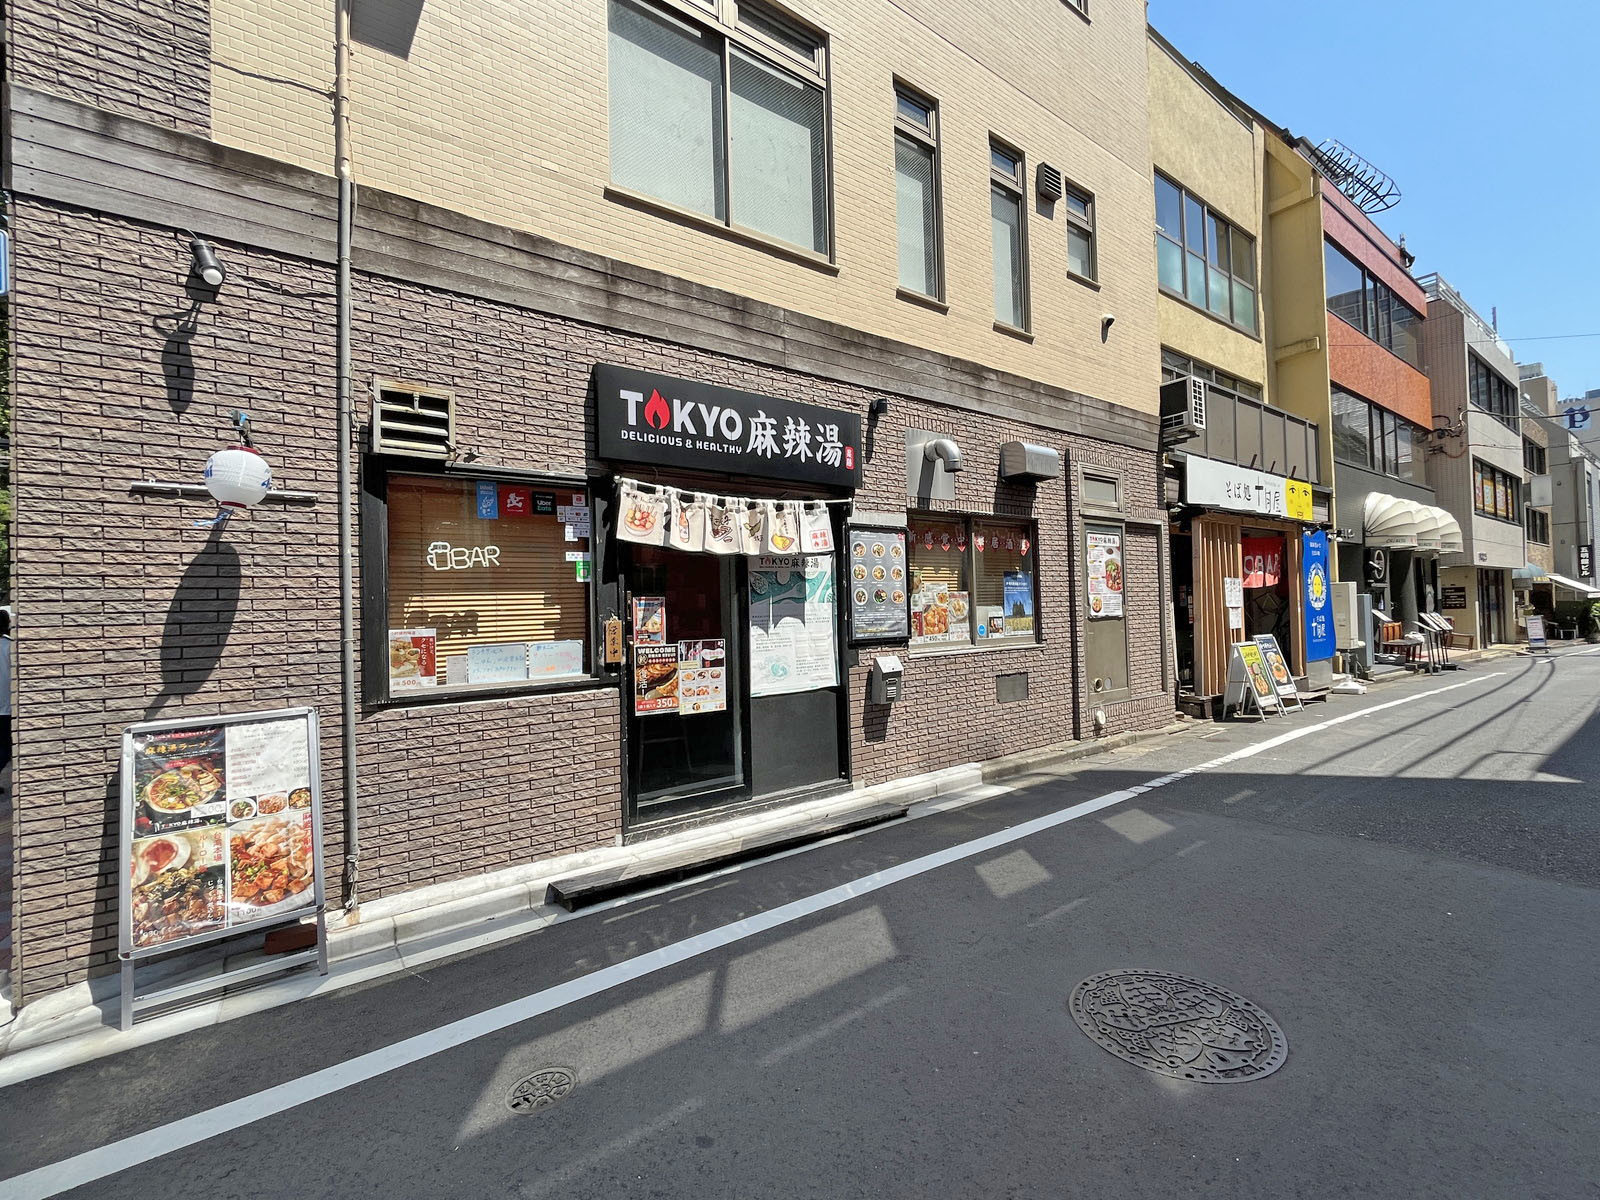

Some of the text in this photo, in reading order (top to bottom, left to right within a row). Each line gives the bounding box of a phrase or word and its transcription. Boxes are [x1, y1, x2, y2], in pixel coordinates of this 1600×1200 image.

[619, 388, 844, 468] TOKYO 麻辣湯
[621, 429, 742, 455] DELICIOUS & HEALTHY
[1226, 480, 1252, 501] そば処
[451, 545, 500, 569] BAR
[637, 646, 676, 655] WELCOME
[656, 698, 673, 709] 350
